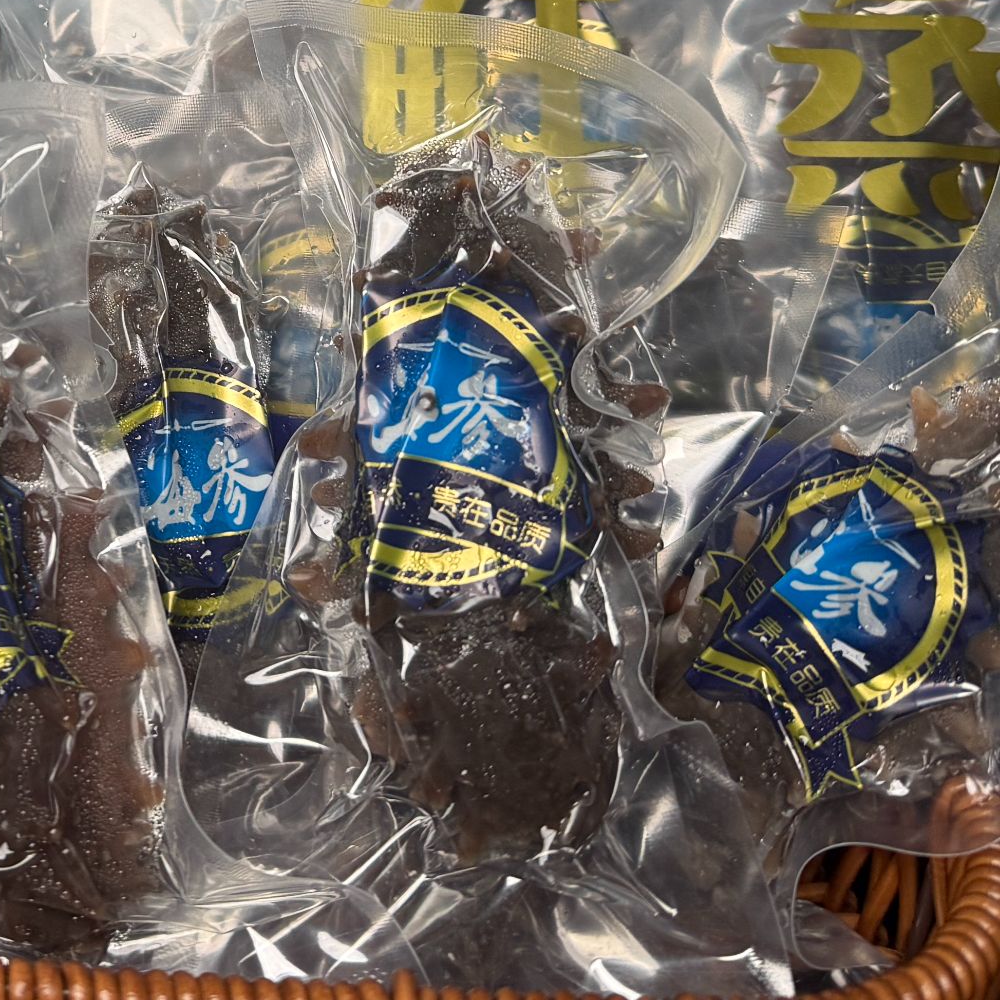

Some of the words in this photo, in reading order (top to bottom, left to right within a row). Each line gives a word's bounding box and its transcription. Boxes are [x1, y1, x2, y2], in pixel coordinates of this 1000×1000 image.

[431, 486, 552, 556] 贵在品质
[747, 618, 842, 720] 贵在品质
